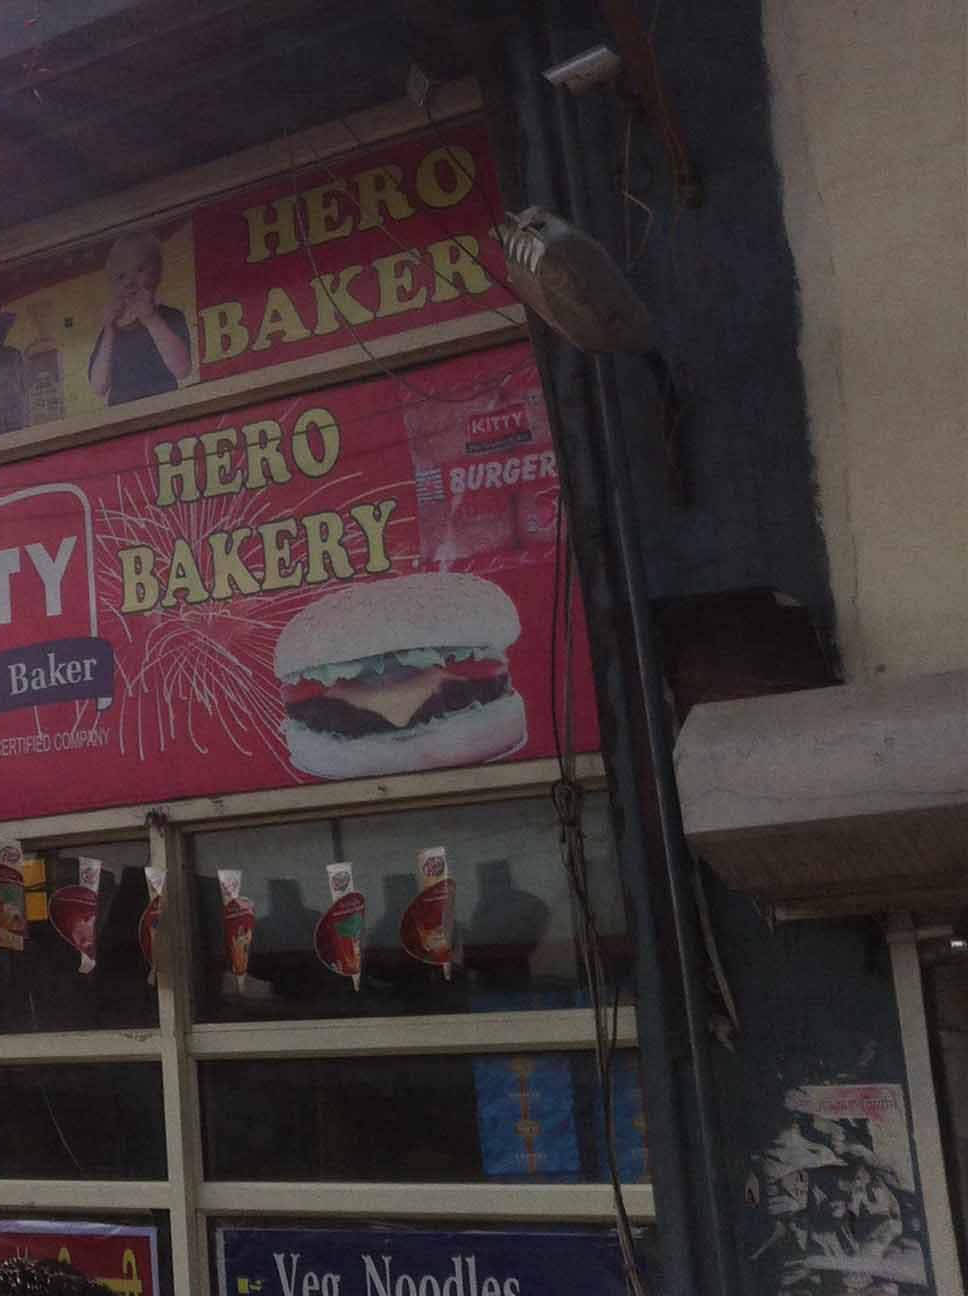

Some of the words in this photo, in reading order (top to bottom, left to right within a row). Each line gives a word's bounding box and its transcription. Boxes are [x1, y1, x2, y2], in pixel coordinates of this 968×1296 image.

[245, 145, 475, 263] HERO
[199, 234, 494, 363] BAKER
[471, 410, 523, 433] KITTY
[153, 407, 341, 508] HERO
[449, 450, 559, 496] BURGER
[117, 497, 398, 613] BAKERY
[8, 653, 97, 696] Baker
[54, 726, 112, 752] COMPANY
[361, 1254, 520, 1296] Noodles
